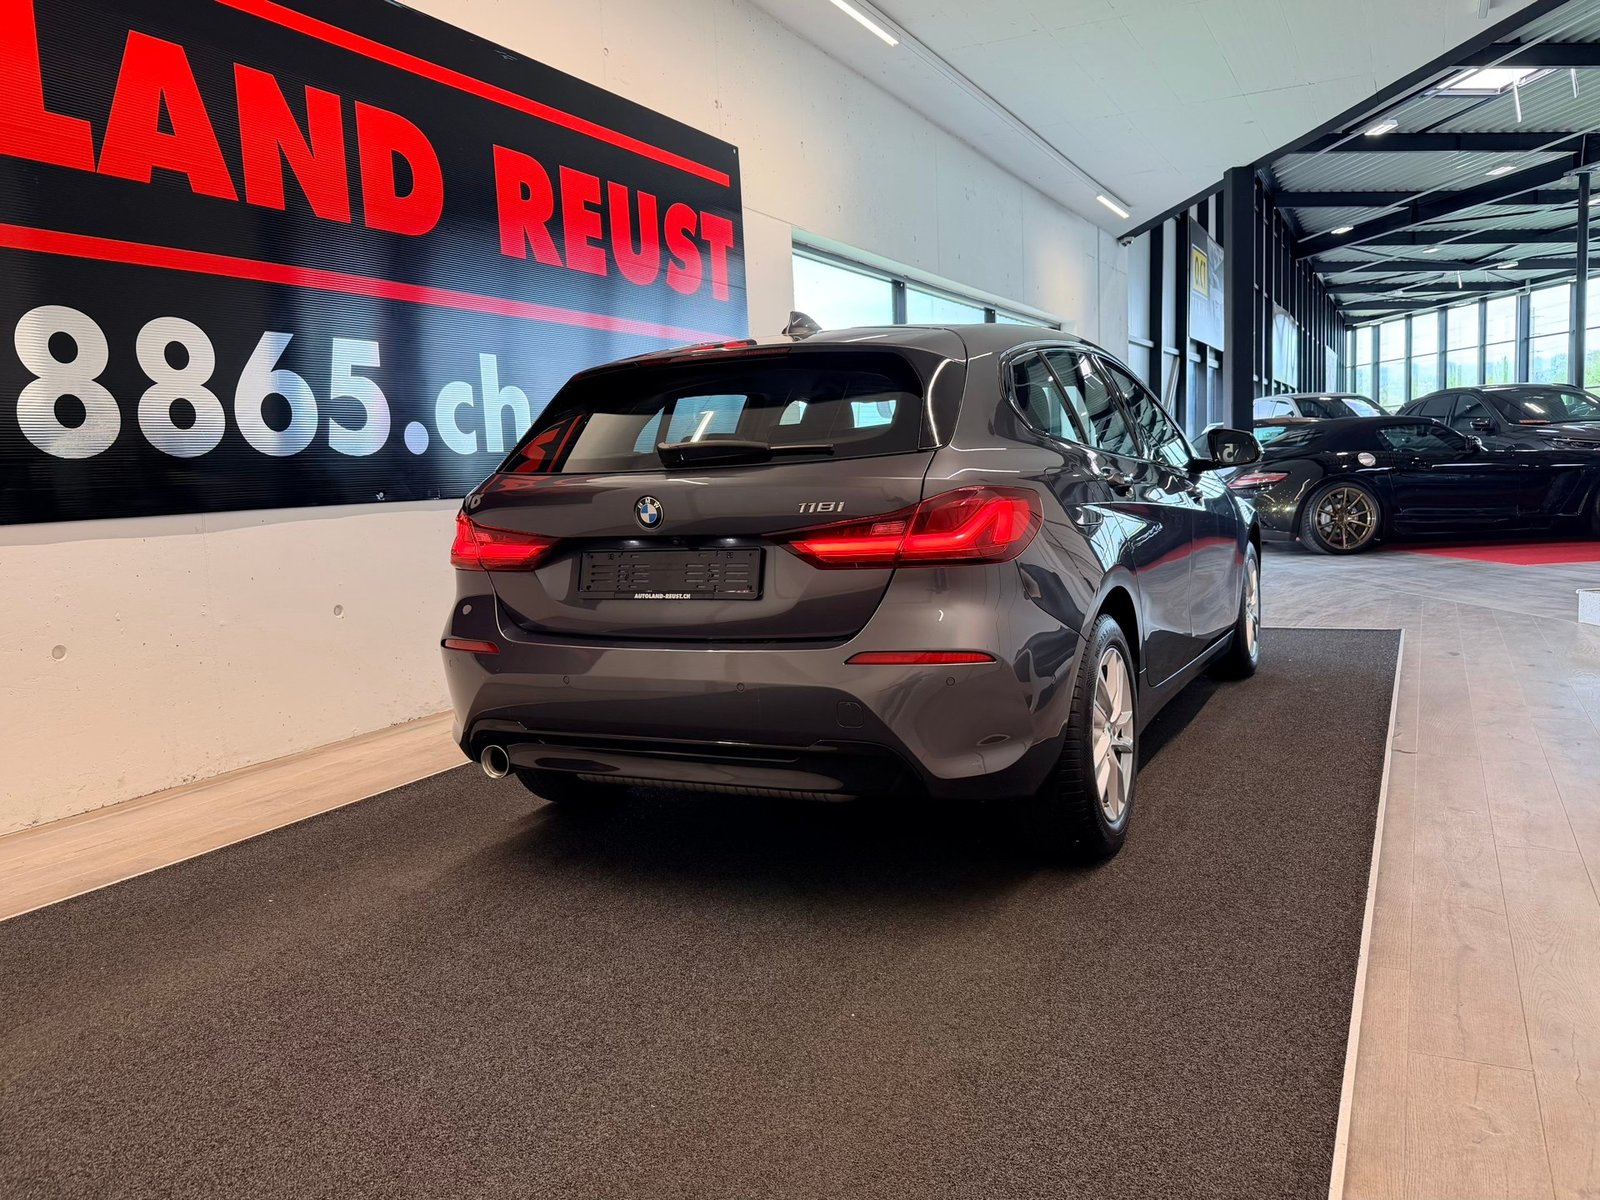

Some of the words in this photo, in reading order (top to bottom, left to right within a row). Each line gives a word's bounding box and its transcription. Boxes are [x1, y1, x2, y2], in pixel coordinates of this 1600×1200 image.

[0, 0, 444, 236] LAND
[493, 144, 733, 301] REUST
[14, 305, 531, 459] 8865.ch
